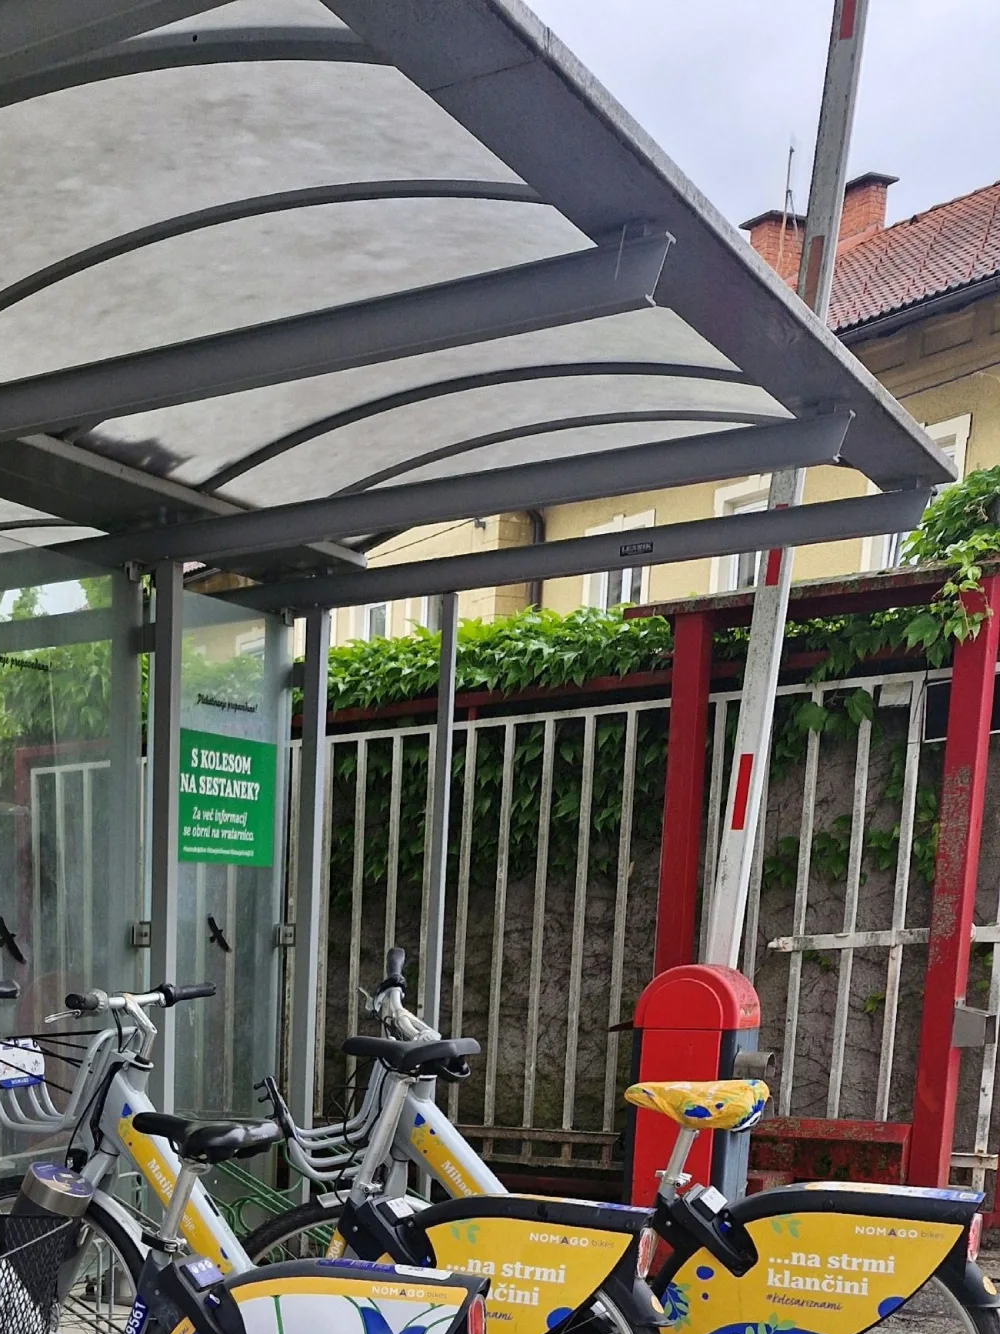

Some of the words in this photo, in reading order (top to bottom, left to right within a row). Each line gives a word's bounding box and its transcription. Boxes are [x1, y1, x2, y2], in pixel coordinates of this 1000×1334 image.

[191, 748, 198, 768] S
[200, 750, 252, 775] KOLESOM
[180, 773, 197, 794] NA
[199, 775, 261, 801] SESTANEK?
[192, 806, 201, 821] Za
[214, 808, 248, 827] informacij
[183, 826, 191, 837] se
[192, 823, 211, 838] obrni
[211, 827, 220, 838] na
[529, 1232, 589, 1247] NOMAGO
[592, 1239, 615, 1249] bikes
[855, 1226, 918, 1239] NOMAGO
[919, 1230, 945, 1240] bikes
[501, 1261, 566, 1284] strmi
[769, 1251, 821, 1268] ...na
[827, 1253, 895, 1274] strmi
[372, 1286, 425, 1298] NOMAGO
[427, 1291, 447, 1299] bikes
[767, 1268, 868, 1296] klančini
[486, 1282, 540, 1306] čini
[766, 1293, 843, 1311] #kolesariznami
[485, 1310, 513, 1321] nami
